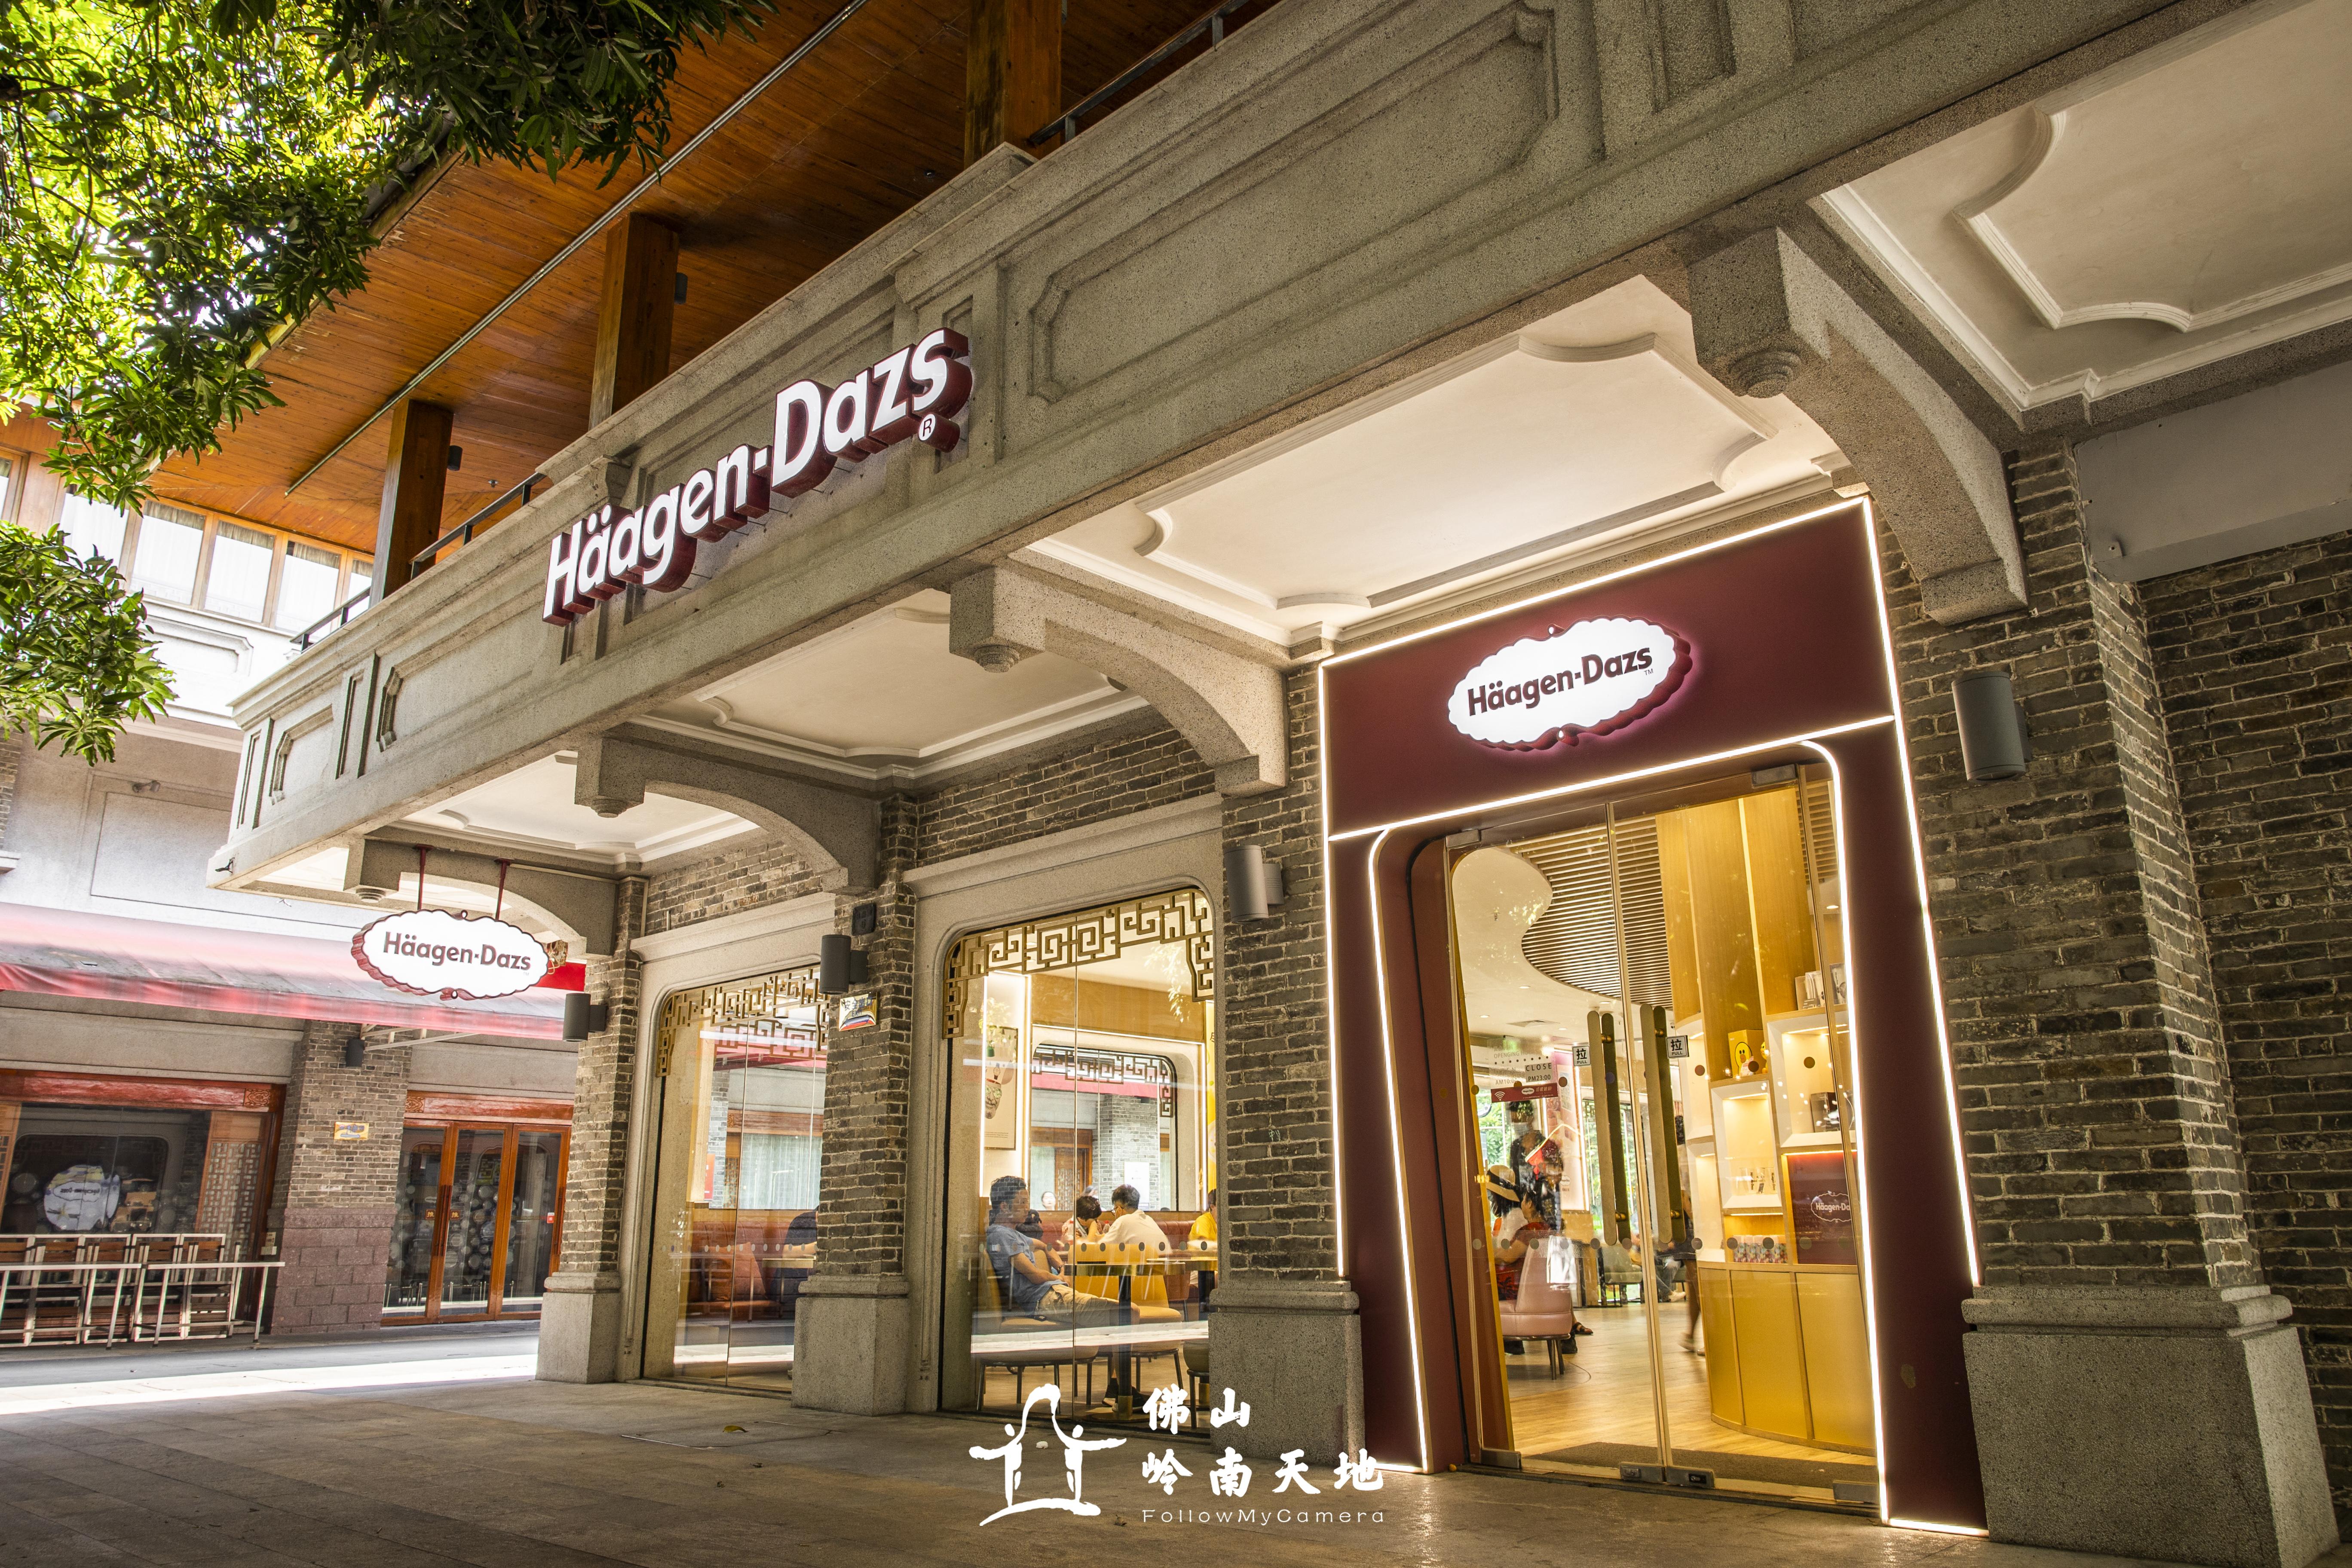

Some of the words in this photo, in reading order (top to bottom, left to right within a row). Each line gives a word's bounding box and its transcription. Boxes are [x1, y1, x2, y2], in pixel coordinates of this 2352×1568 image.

[542, 328, 948, 622] Häagen-Dazs
[1467, 647, 1653, 717] Häagen-Dazs
[383, 931, 531, 971] Häagen-Dazs
[844, 996, 873, 1011] 安全出口
[1671, 1039, 1683, 1051] 拉
[1576, 1048, 1587, 1060] 拉
[1526, 1063, 1552, 1072] CLOSE
[1815, 1203, 1850, 1213] Häagen-Da
